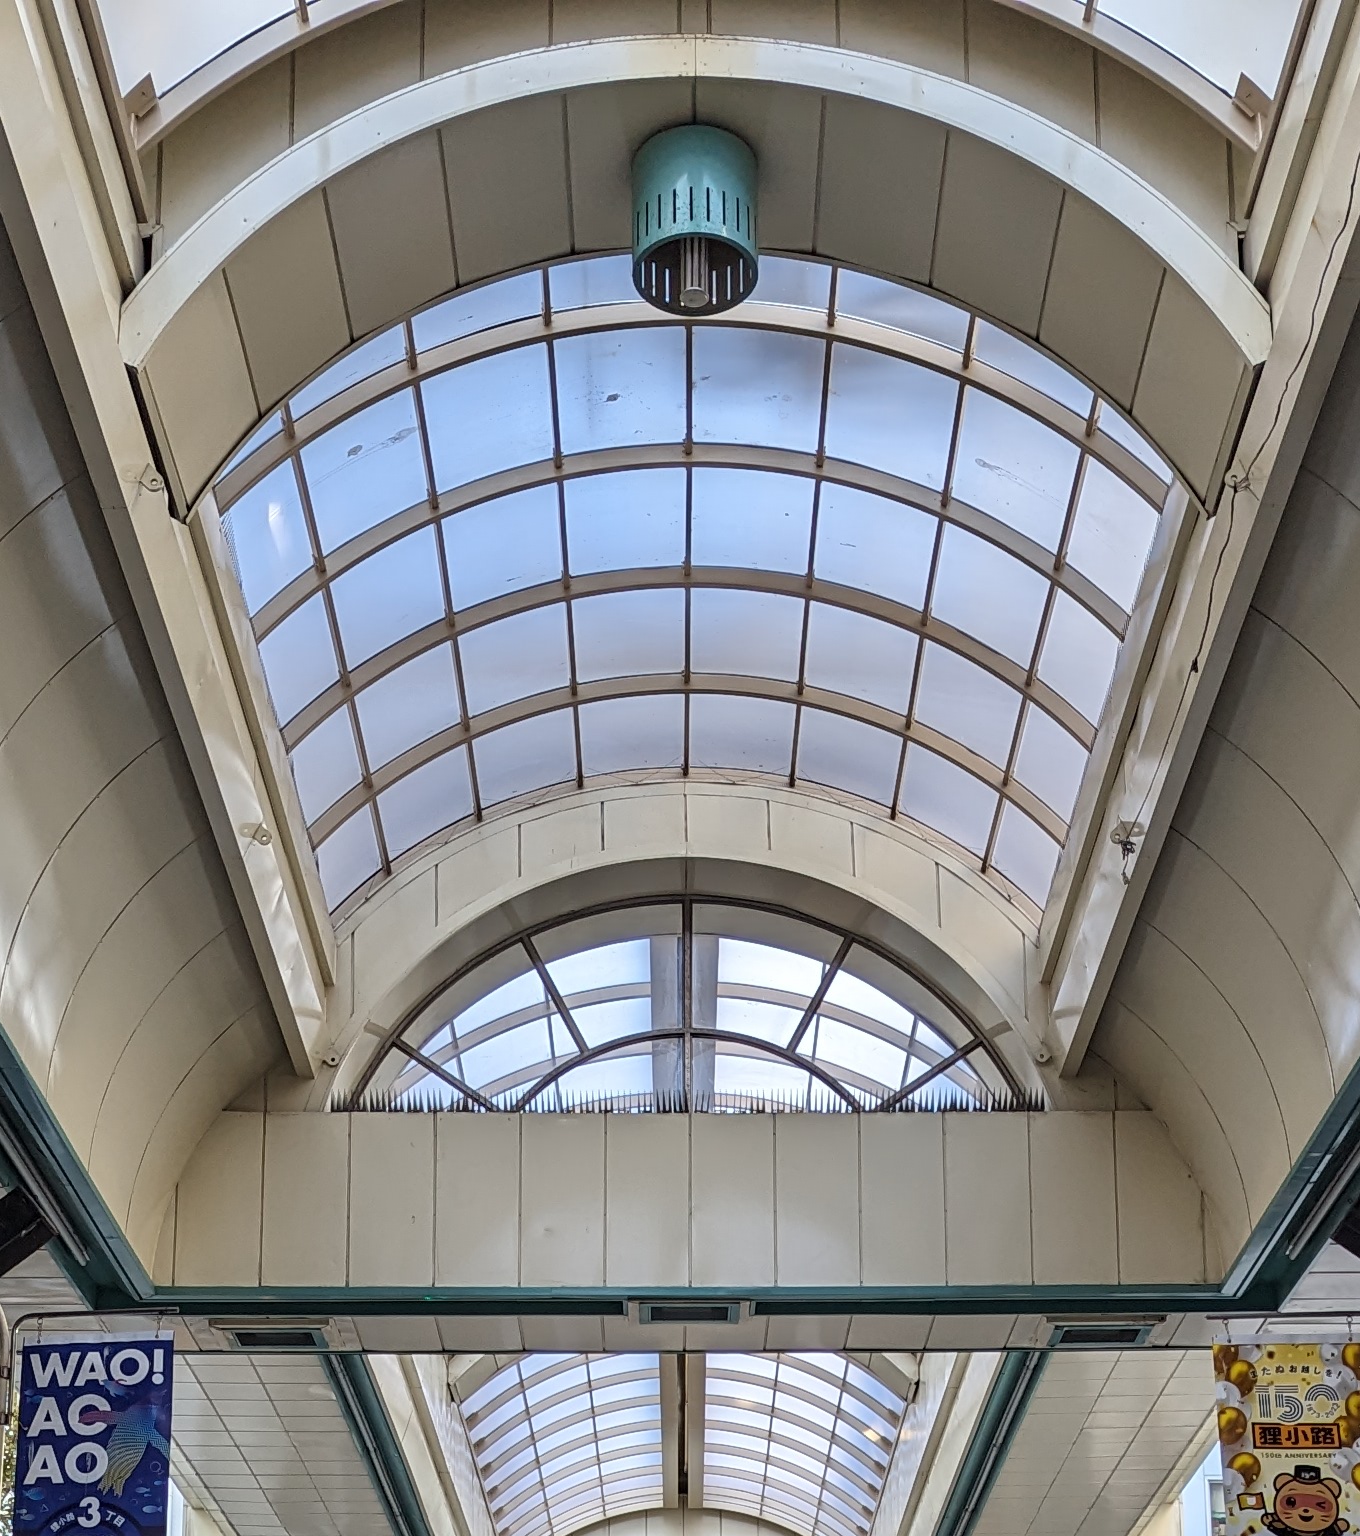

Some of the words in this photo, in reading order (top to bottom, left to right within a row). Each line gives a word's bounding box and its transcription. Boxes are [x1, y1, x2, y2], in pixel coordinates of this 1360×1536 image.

[29, 1348, 166, 1388] WAO!
[1257, 1426, 1337, 1447] 狸小路
[23, 1442, 109, 1486] AO
[77, 1497, 102, 1529] 3
